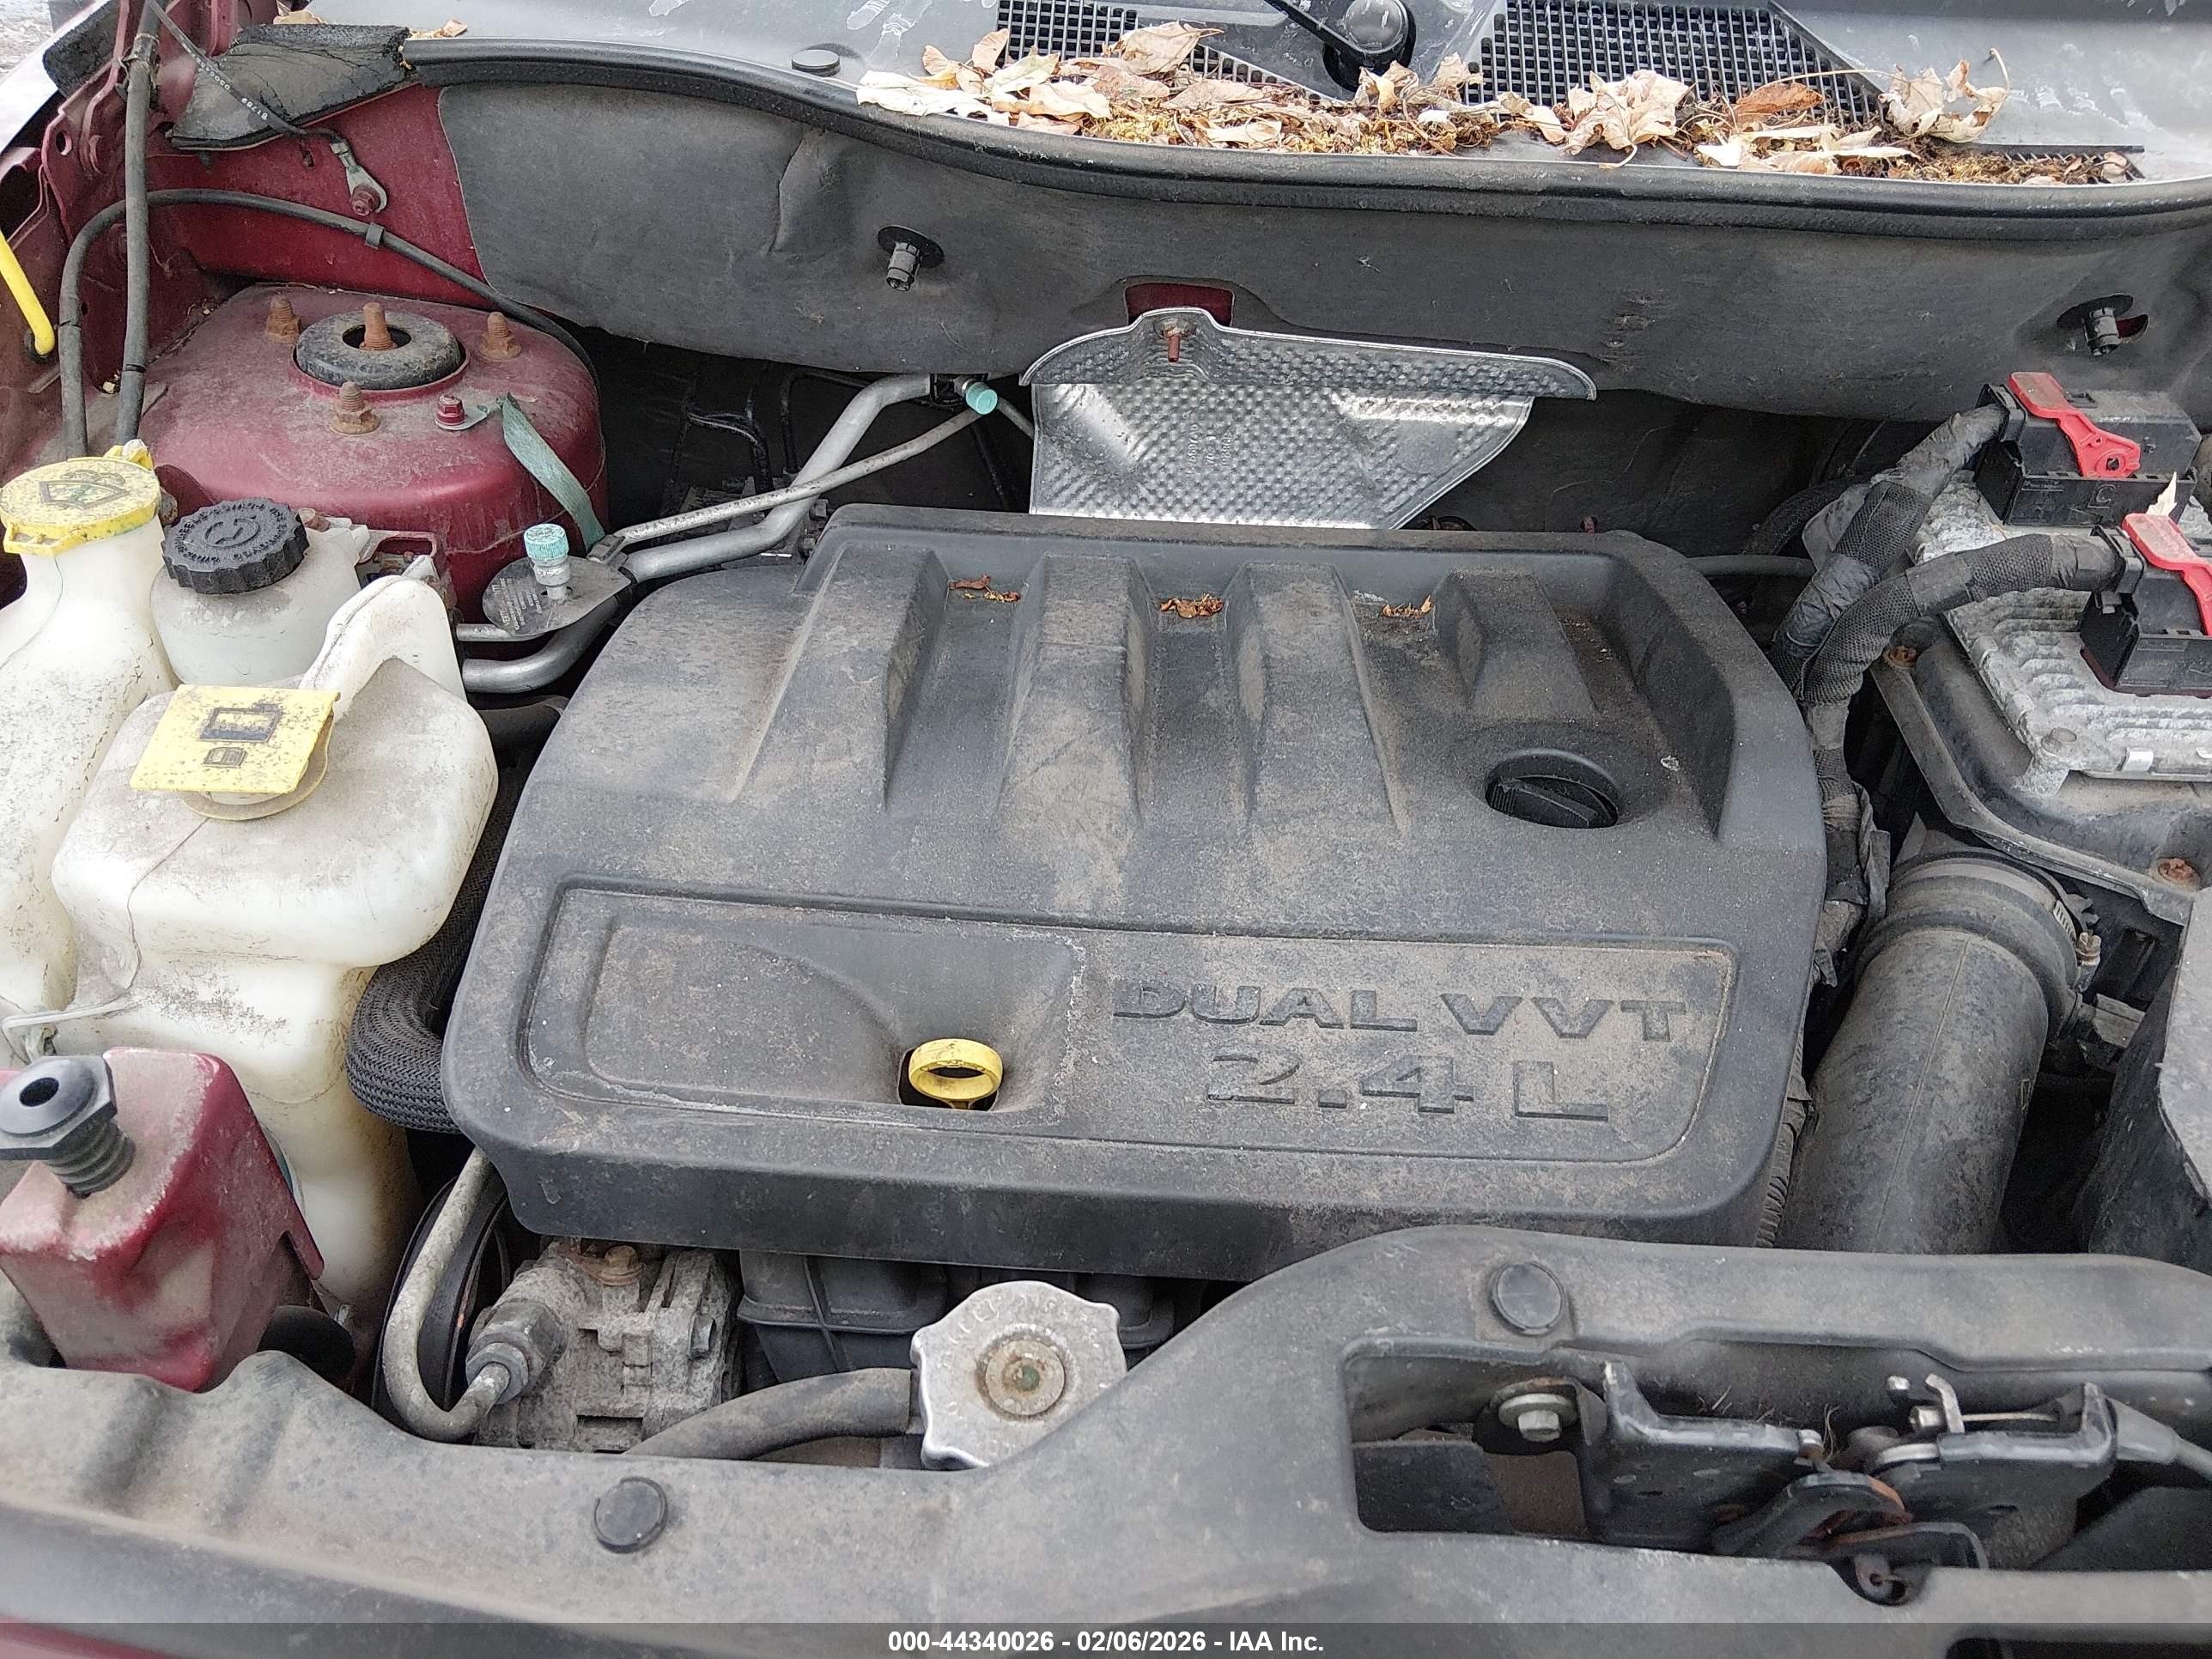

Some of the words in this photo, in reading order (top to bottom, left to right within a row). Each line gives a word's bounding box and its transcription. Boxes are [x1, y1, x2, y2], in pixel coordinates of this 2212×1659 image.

[1112, 979, 1418, 1031] DUAL
[1438, 993, 1687, 1042] VVT
[1206, 1054, 1475, 1115] 2.4
[1513, 1059, 1609, 1122] L
